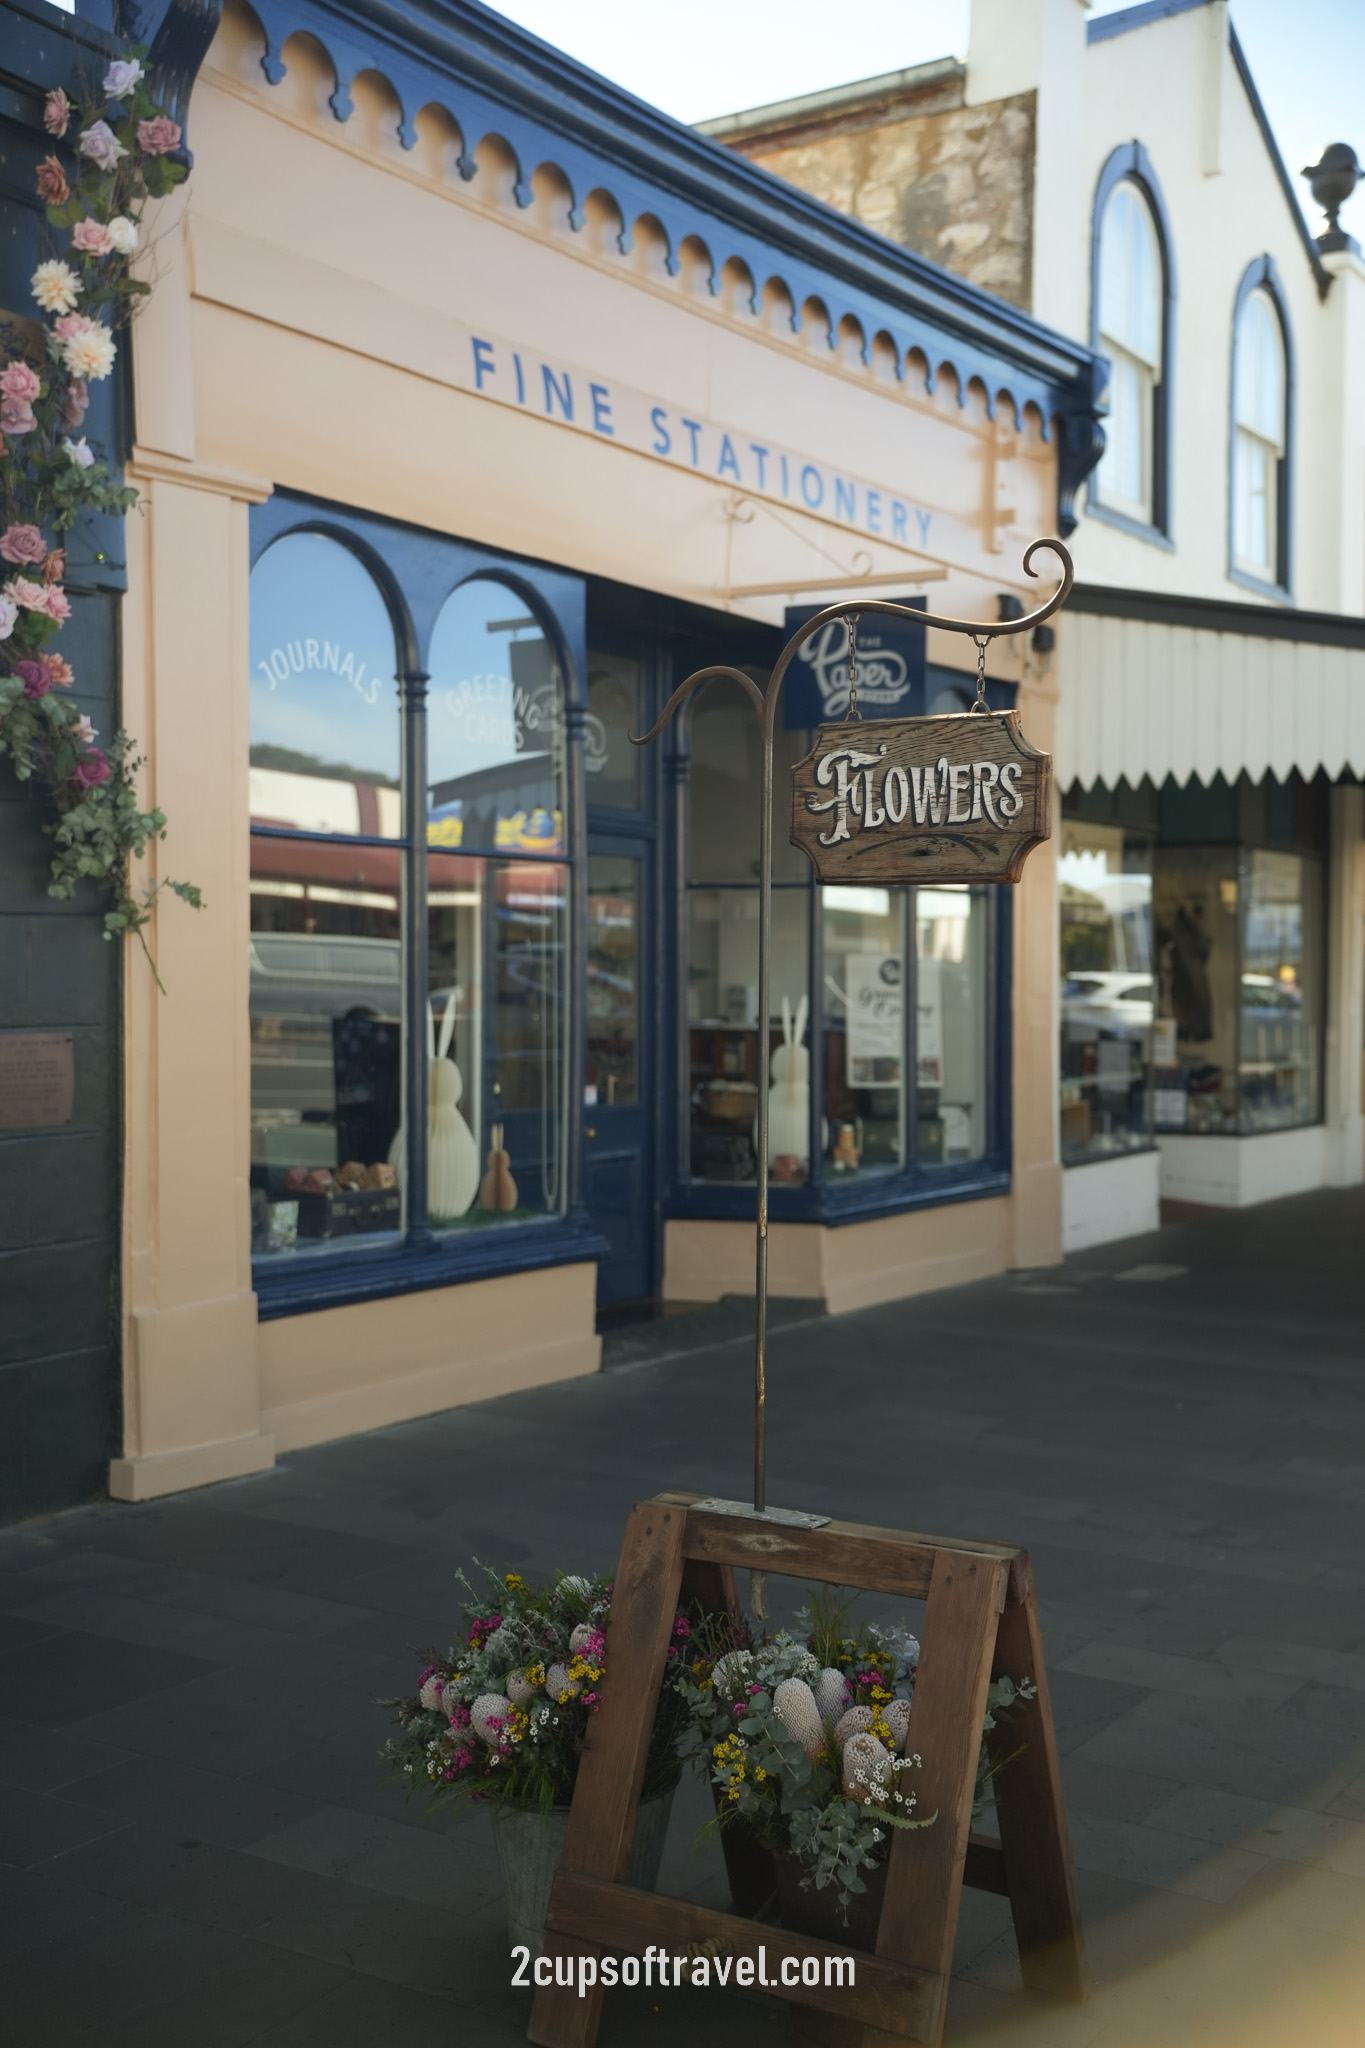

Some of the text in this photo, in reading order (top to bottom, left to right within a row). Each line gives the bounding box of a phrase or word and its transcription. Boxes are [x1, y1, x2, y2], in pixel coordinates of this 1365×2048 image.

[471, 336, 932, 550] FINE STATIONERY
[258, 638, 382, 704] JOURNALS
[798, 617, 908, 702] Paper
[858, 635, 882, 648] THE
[447, 673, 542, 730] GREETING
[806, 744, 1024, 845] FLOWERS
